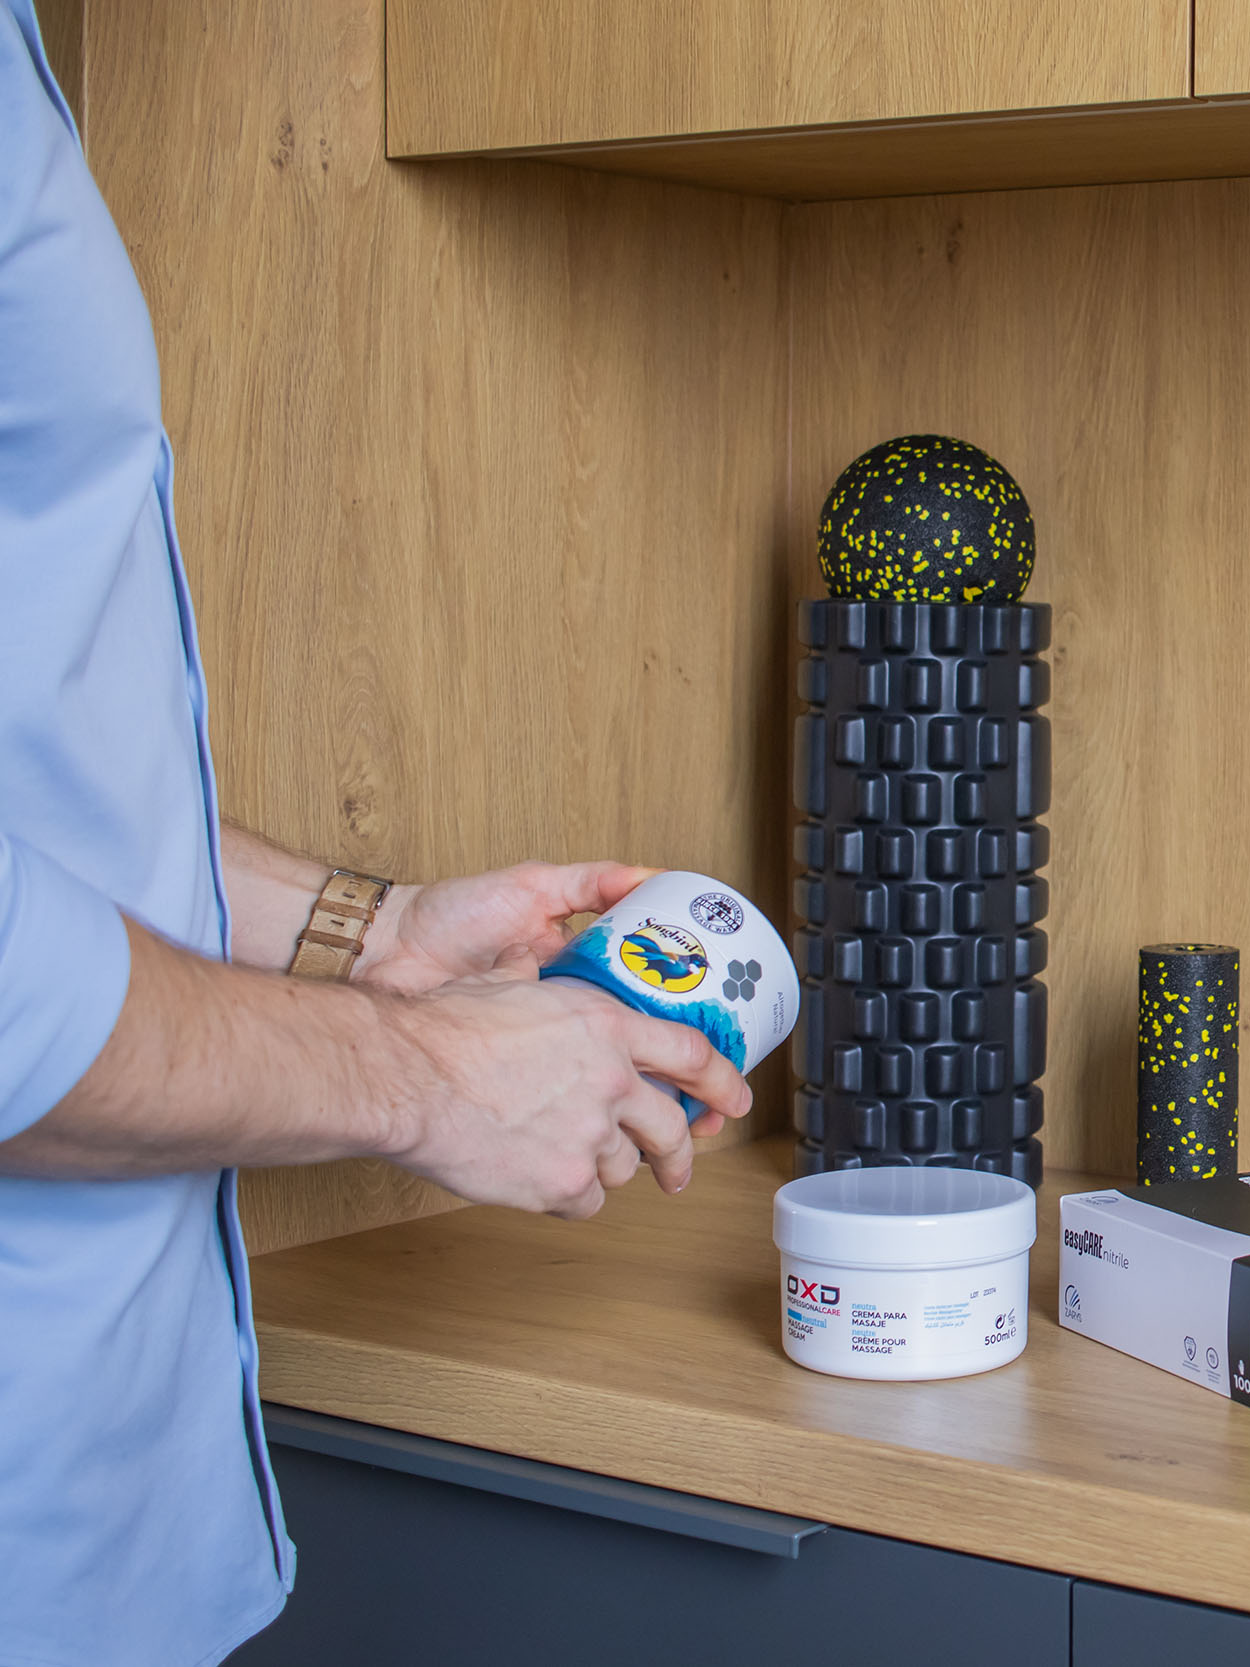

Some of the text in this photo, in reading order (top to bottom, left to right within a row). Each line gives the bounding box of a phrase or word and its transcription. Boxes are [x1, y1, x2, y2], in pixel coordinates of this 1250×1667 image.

[638, 917, 699, 953] Songbird
[1064, 1228, 1130, 1270] easyCARE nitrile
[852, 1310, 907, 1320] CREMA PARA
[852, 1319, 886, 1328] MASAJE
[882, 1338, 906, 1346] POUR
[984, 1330, 1010, 1346] 500ml
[852, 1345, 892, 1354] MASSAGE
